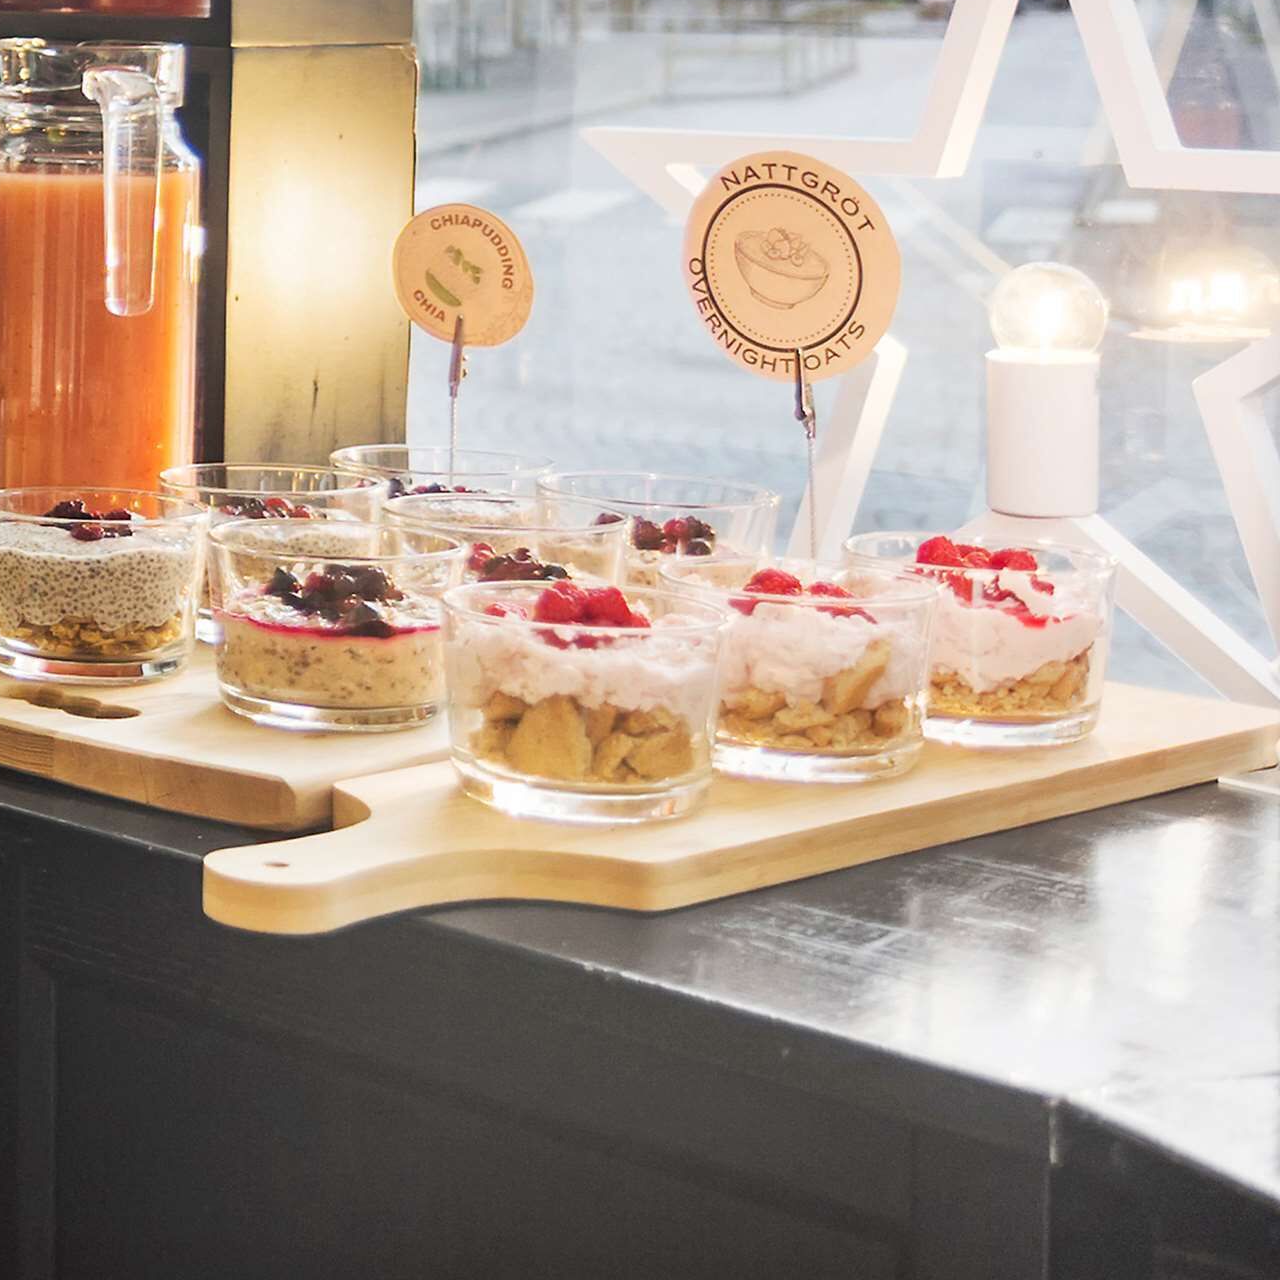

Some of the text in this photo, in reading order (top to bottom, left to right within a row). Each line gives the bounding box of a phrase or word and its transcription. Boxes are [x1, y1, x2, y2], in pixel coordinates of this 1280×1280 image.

[720, 163, 875, 233] NATTGRÖT
[430, 214, 514, 290] CHIAPUDDING
[689, 257, 865, 373] OVERNIGHT OATS
